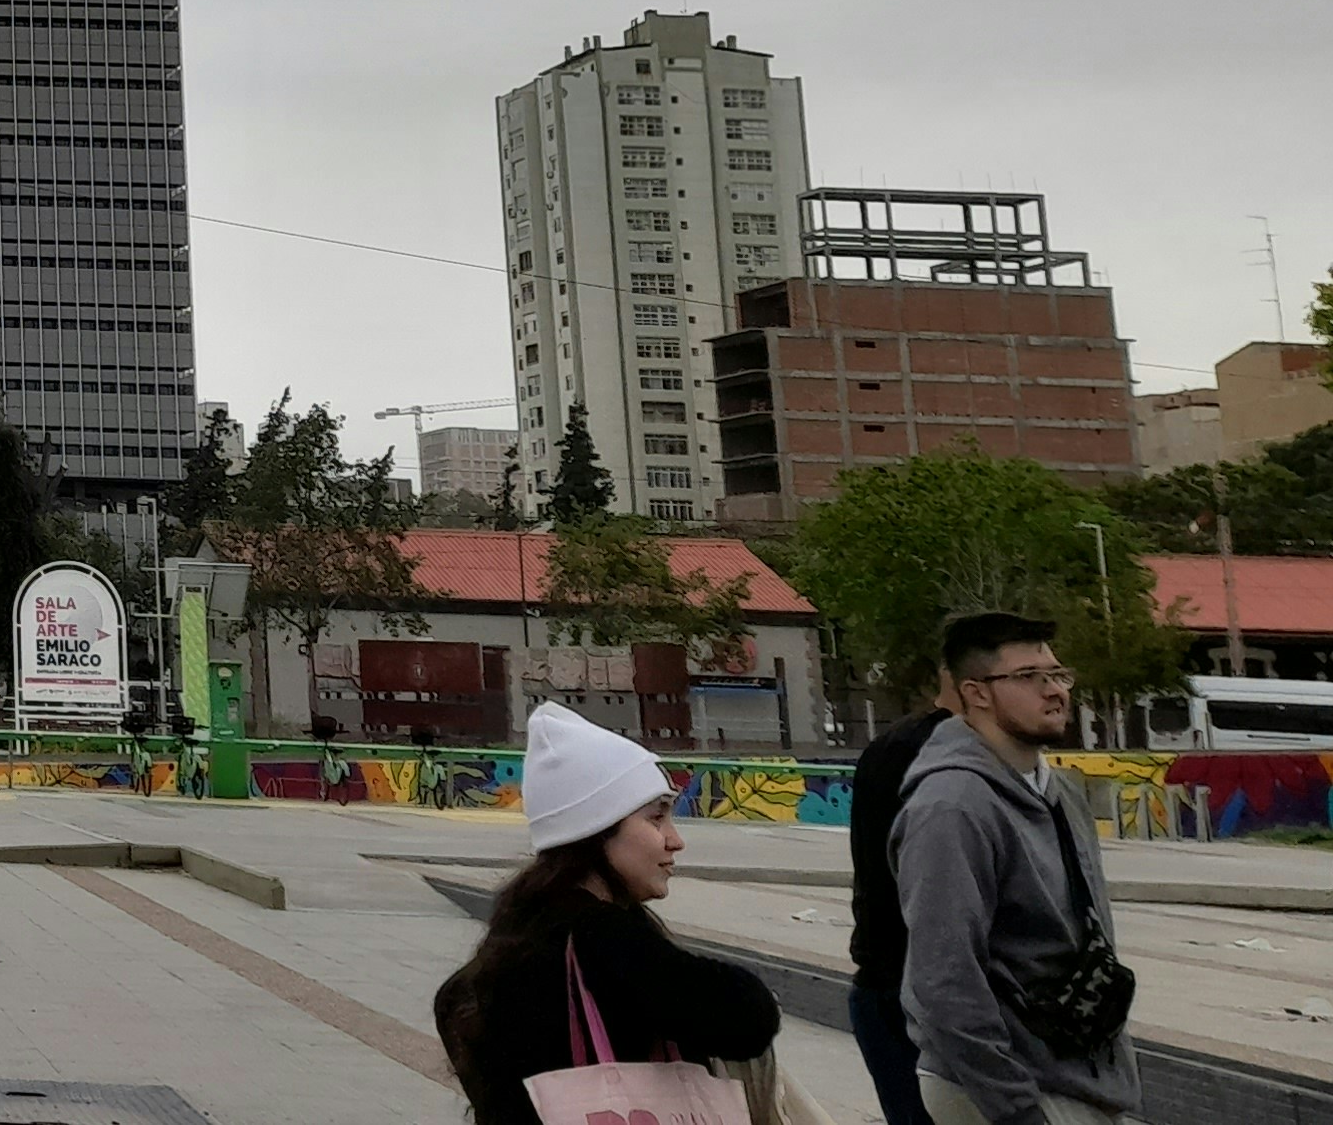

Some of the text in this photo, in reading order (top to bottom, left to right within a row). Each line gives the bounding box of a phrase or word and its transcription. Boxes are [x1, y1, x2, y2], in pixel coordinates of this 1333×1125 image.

[35, 596, 77, 610] SALA
[36, 610, 57, 623] DE
[36, 623, 78, 637] ARTE
[36, 639, 90, 652] EMILIO
[36, 653, 102, 667] SARACO
